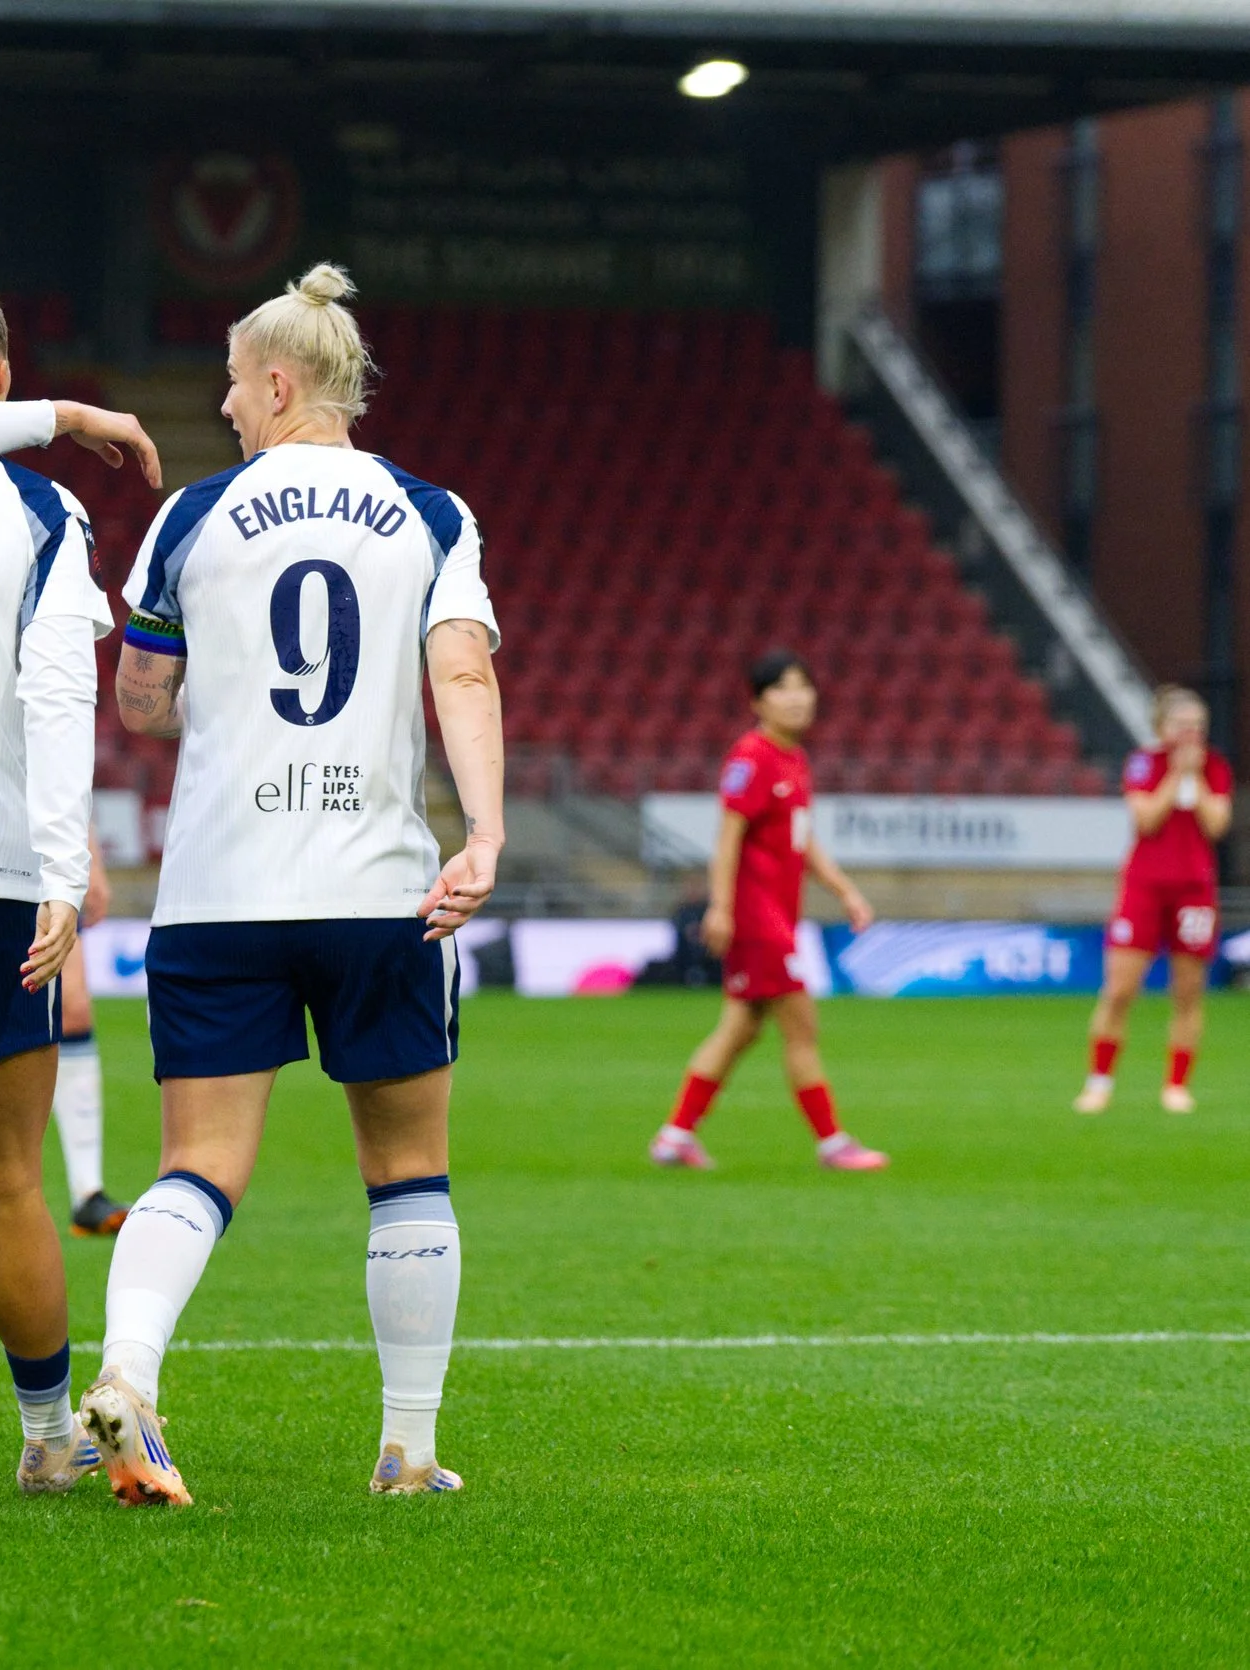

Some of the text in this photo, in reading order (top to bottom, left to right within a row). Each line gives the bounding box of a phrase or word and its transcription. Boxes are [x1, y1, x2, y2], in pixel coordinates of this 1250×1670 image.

[228, 486, 407, 541] ENGLAND
[270, 558, 361, 727] 9
[322, 764, 365, 779] EYES.
[322, 781, 360, 796] LIPS.
[321, 797, 365, 812] FACE.
